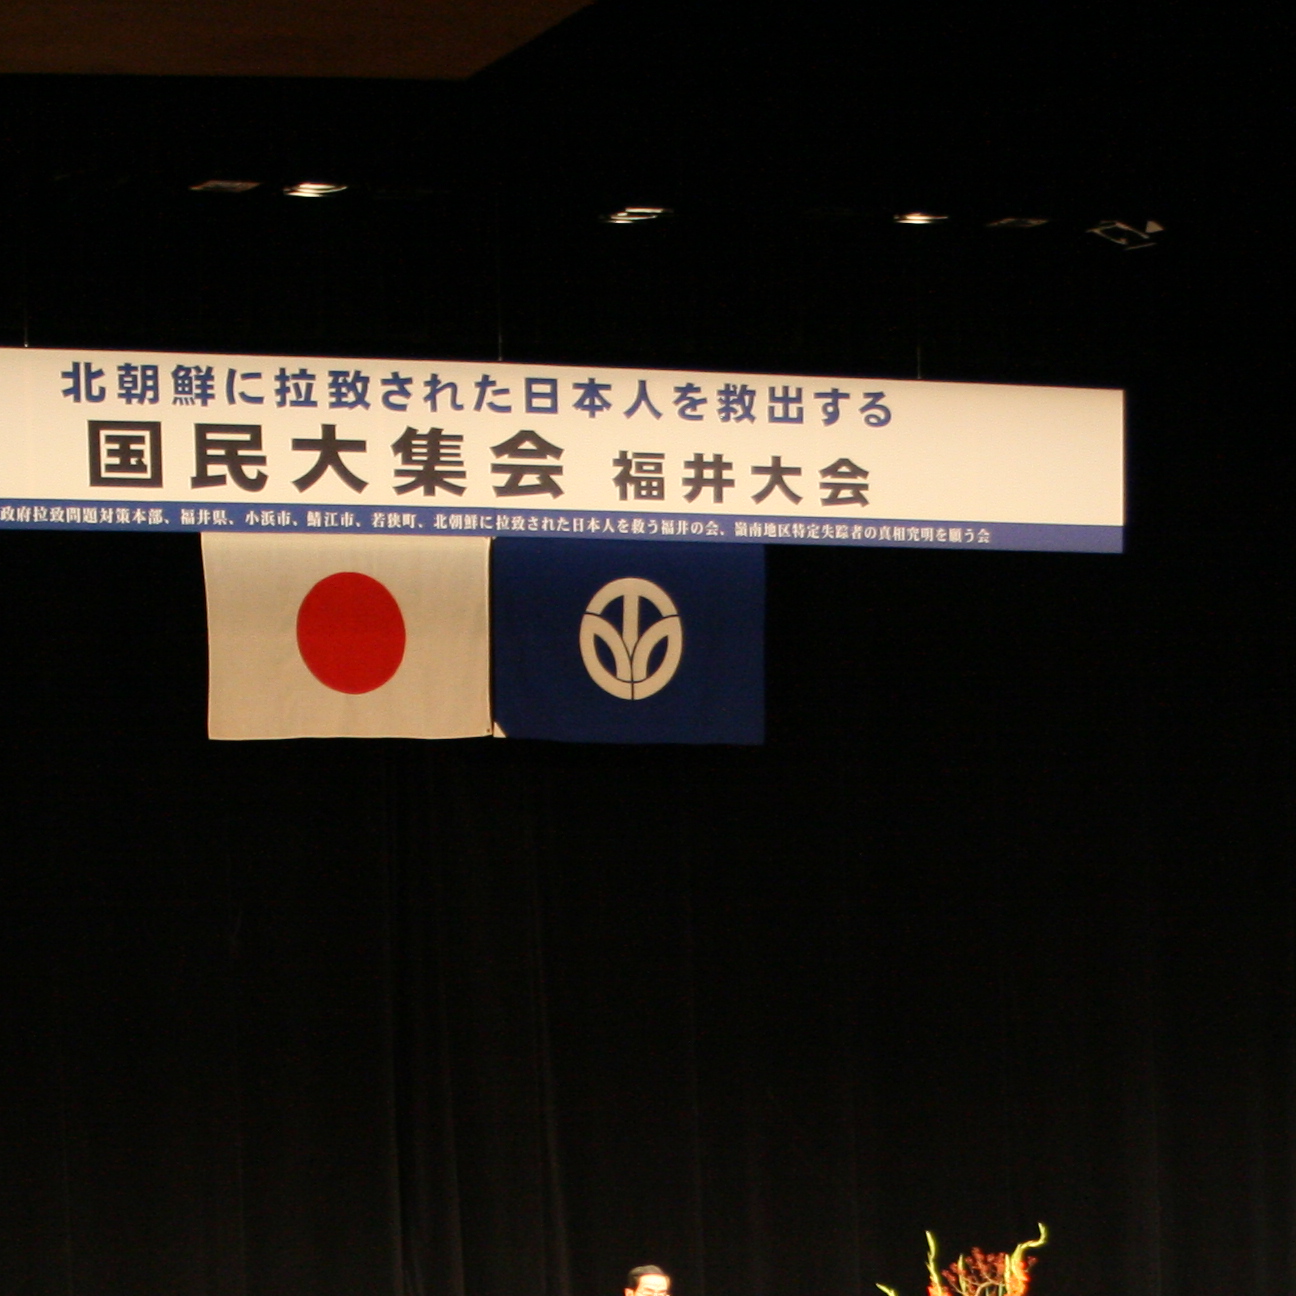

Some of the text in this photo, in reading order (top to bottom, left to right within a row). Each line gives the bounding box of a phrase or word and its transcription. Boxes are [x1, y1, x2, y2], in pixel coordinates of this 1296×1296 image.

[60, 360, 894, 428] 北朝鮮に拉致された日本人を救出する
[87, 420, 871, 508] 国民大集会 福井大会
